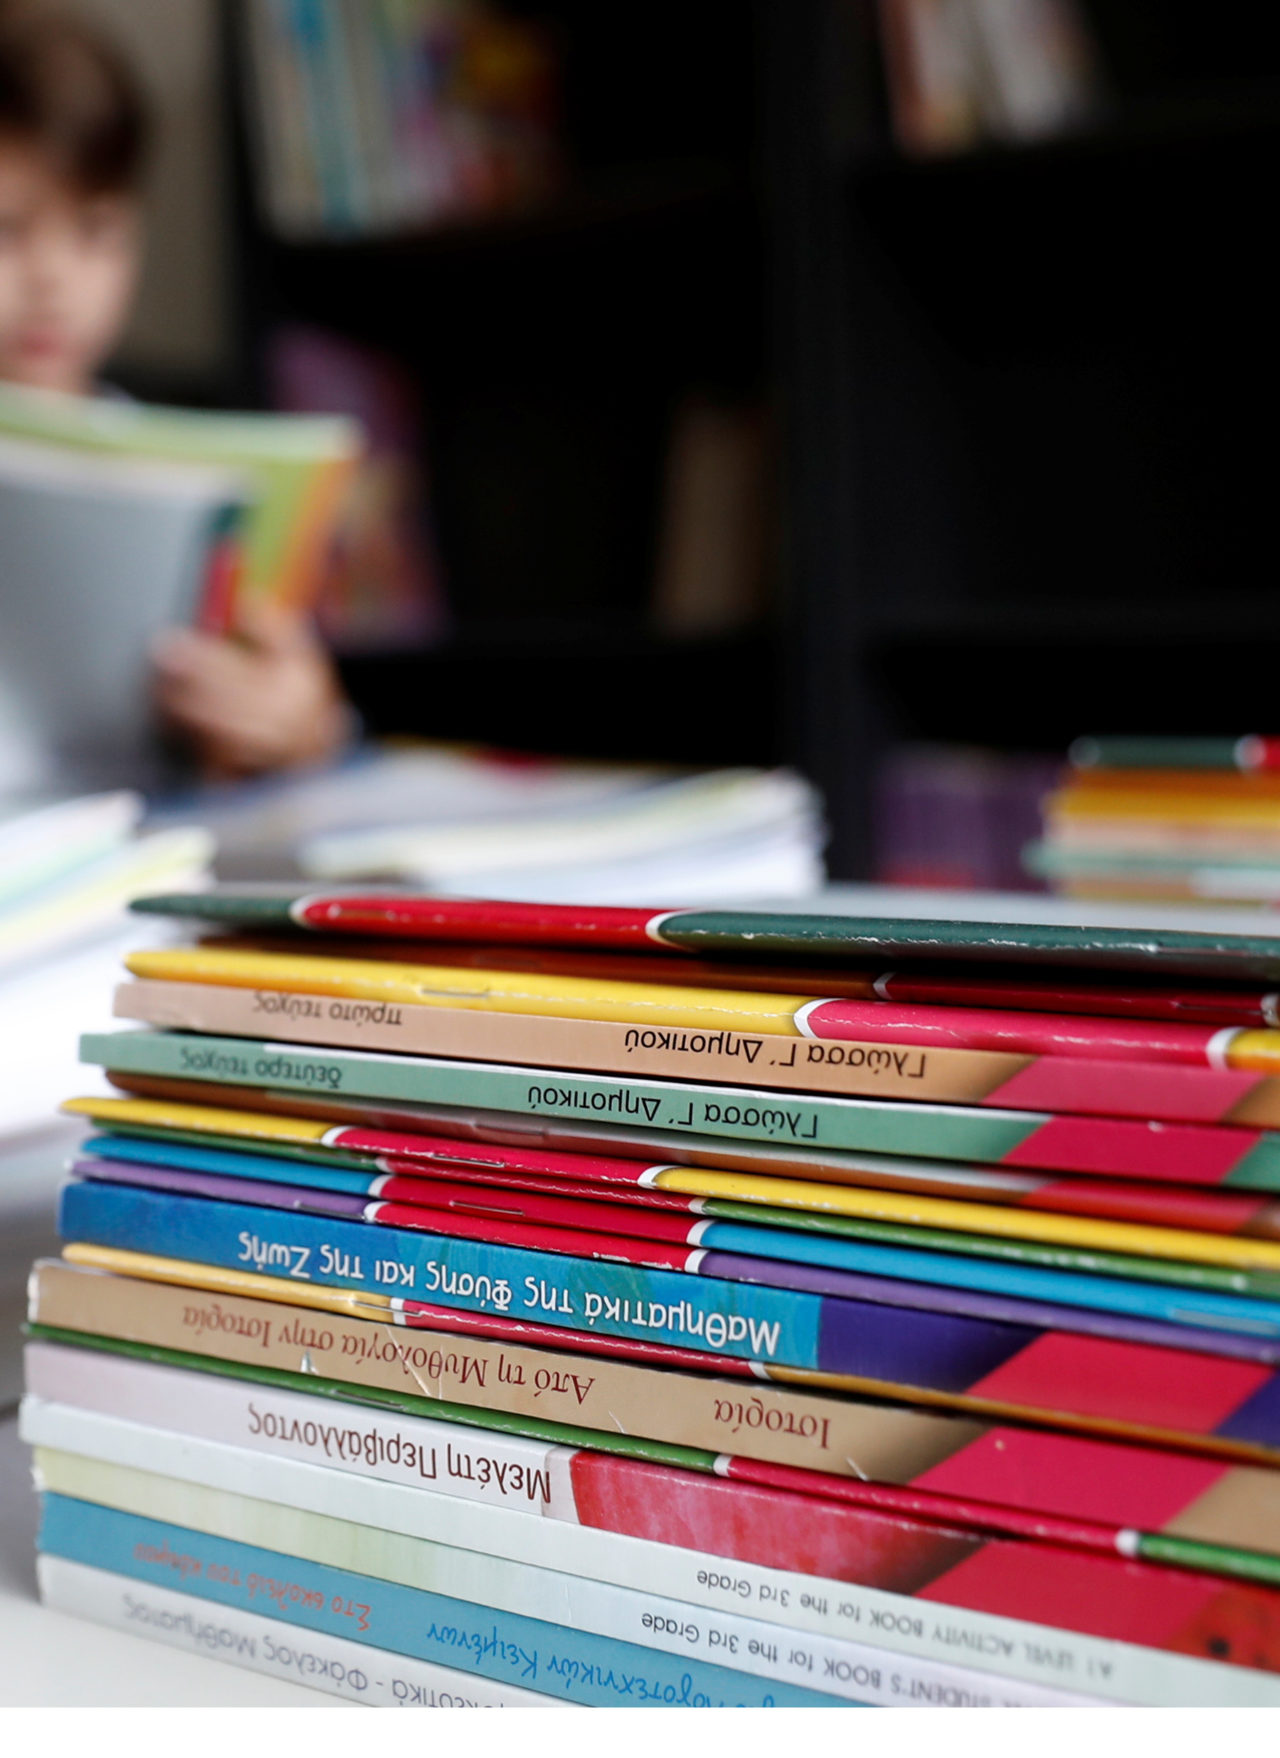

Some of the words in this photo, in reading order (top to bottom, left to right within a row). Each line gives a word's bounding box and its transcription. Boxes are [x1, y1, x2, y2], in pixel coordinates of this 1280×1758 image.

[254, 990, 321, 1021] τεύχος
[327, 1001, 402, 1029] πρώτο
[180, 1046, 249, 1077] τεύχος
[624, 1029, 763, 1063] Δημοτικού
[807, 1044, 927, 1078] Γλώσσα
[255, 1057, 342, 1089] δεύτερο
[527, 1086, 661, 1122] Δημοτικού
[704, 1102, 818, 1138] Γλώσσα
[238, 1230, 311, 1279] Ζωής
[319, 1243, 364, 1278] της
[374, 1260, 415, 1288] και
[426, 1260, 512, 1311] Φύσης
[524, 1276, 574, 1315] της
[182, 1305, 271, 1348] Ιστορία
[279, 1317, 334, 1350] στην
[584, 1293, 781, 1356] Μαθηματικά
[342, 1331, 489, 1389] Μυθολογία
[496, 1354, 526, 1386] τη
[534, 1367, 596, 1405] Από
[714, 1397, 831, 1449] Ιστορία
[248, 1402, 439, 1479] Περιβάλλοντος
[447, 1441, 552, 1503] Μελέτη
[696, 1569, 752, 1599] Grade
[758, 1583, 791, 1608] 3rd
[331, 1596, 371, 1632] Στο
[800, 1593, 829, 1616] the
[837, 1601, 861, 1622] for
[122, 1593, 258, 1659] Μαθήματος
[641, 1612, 700, 1644] Grade
[869, 1607, 923, 1638] BOOK
[427, 1621, 538, 1680] Κειμένων
[707, 1629, 739, 1656] 3rd
[747, 1638, 779, 1663] the
[931, 1623, 1014, 1657] ACTIVITY
[263, 1635, 369, 1692] Φάκελος
[788, 1649, 813, 1672] for
[824, 1656, 881, 1690] BOOK
